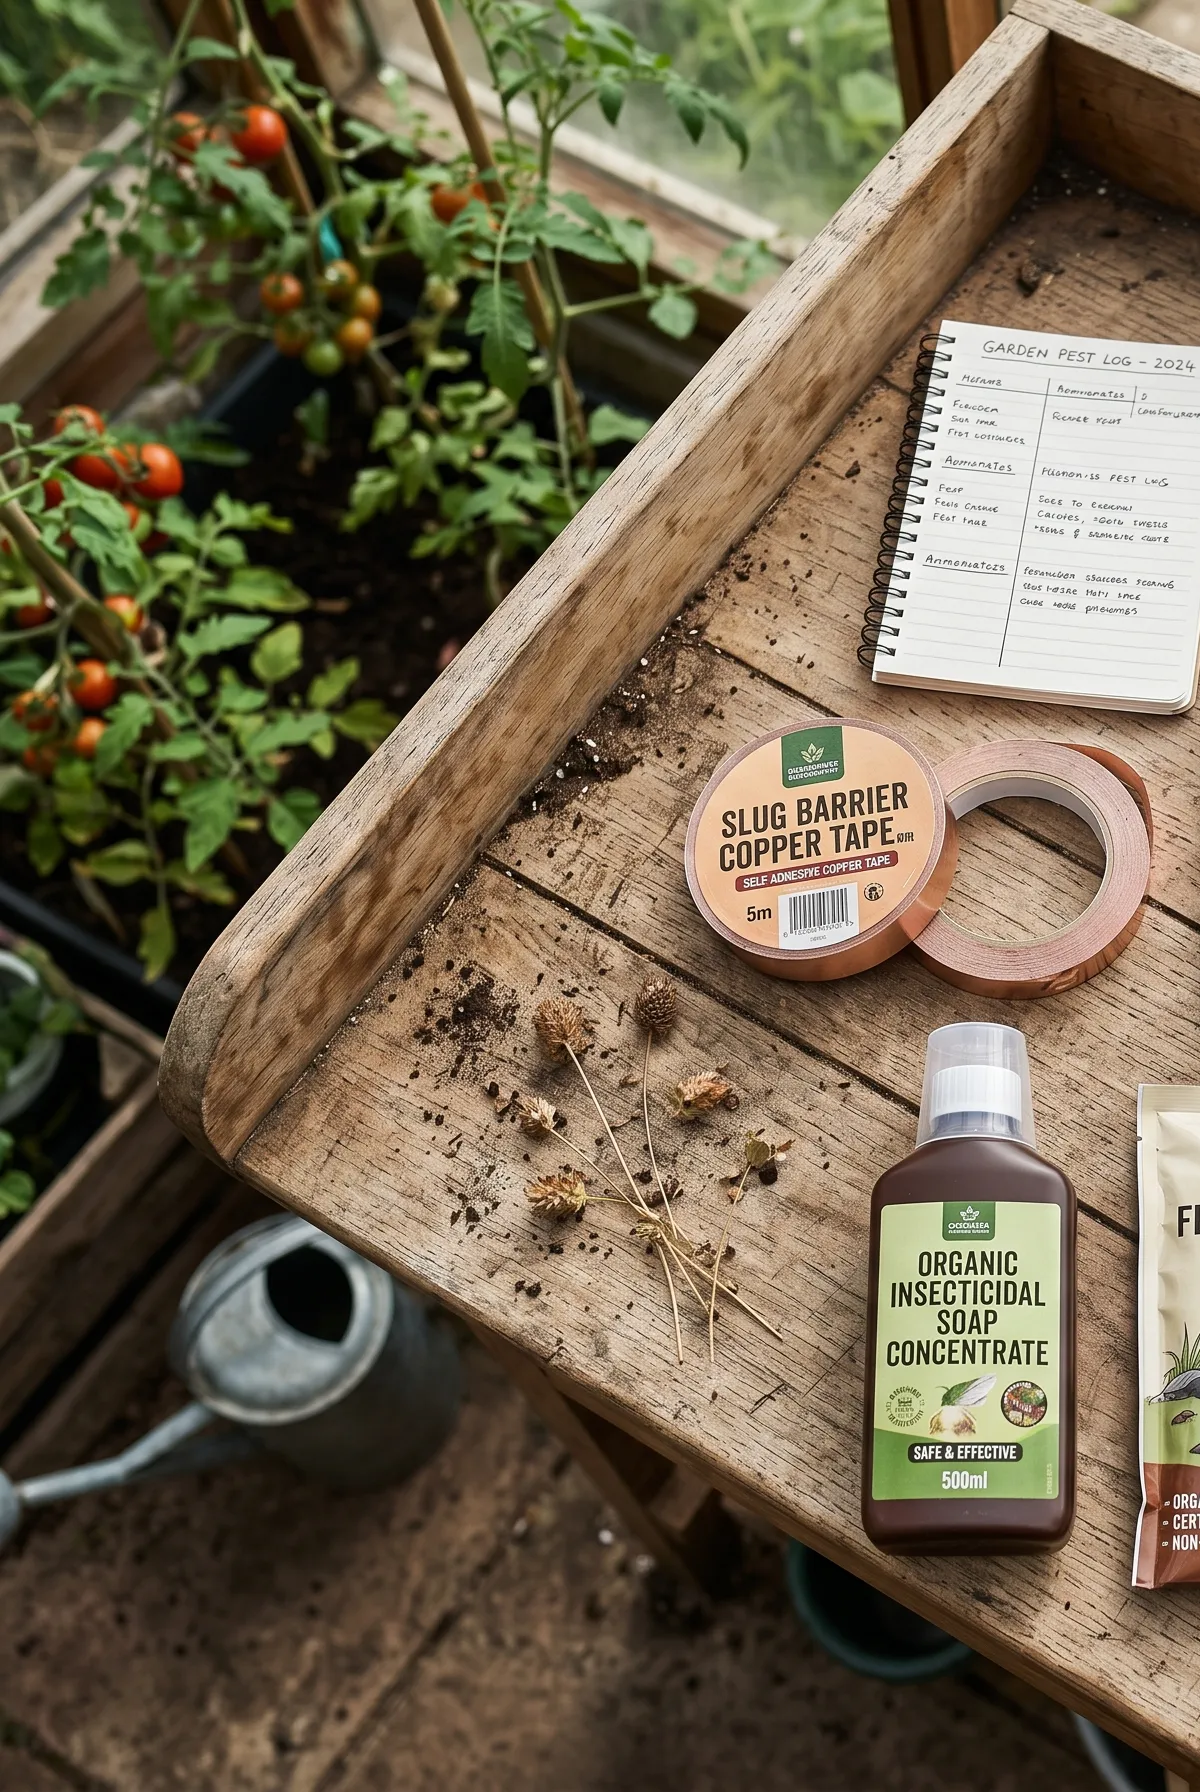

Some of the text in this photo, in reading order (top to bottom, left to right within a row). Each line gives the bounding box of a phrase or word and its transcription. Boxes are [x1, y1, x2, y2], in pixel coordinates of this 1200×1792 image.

[982, 340, 1048, 359] GARDEN
[1058, 349, 1096, 364] PEST
[1102, 352, 1132, 367] LOG
[1154, 358, 1196, 373] 2024
[721, 781, 909, 839] SLUG BARRIER
[719, 816, 895, 872] COPPER TAPE
[743, 875, 768, 889] SELF
[864, 853, 891, 868] TAPE
[746, 905, 772, 922] 5m
[918, 1250, 1018, 1277] ORGANIC
[890, 1280, 1046, 1308] INSECTICIDAL
[937, 1309, 998, 1335] SOAP
[886, 1339, 1049, 1367] CONCENTRATE
[913, 1444, 1017, 1461] SAFE & EFFECTIVE
[941, 1470, 988, 1490] 500ml
